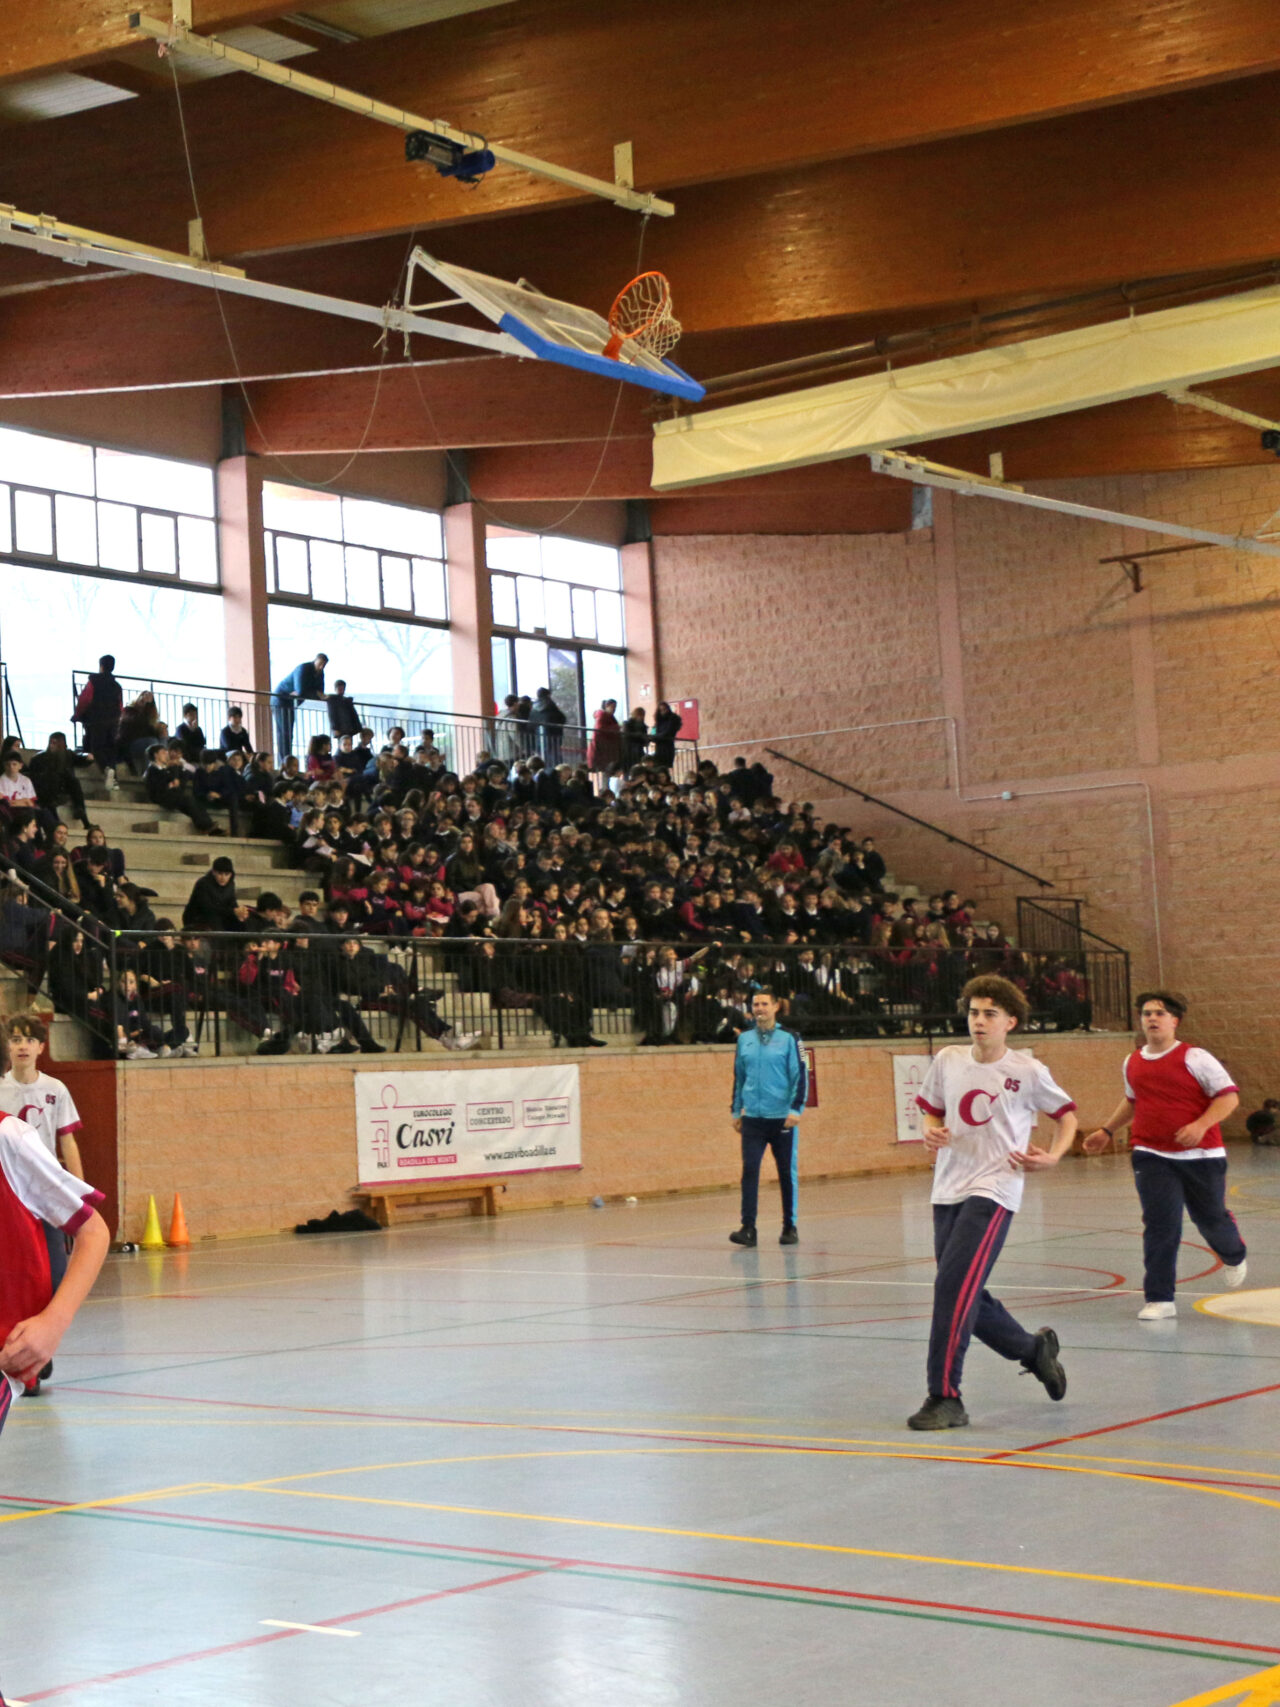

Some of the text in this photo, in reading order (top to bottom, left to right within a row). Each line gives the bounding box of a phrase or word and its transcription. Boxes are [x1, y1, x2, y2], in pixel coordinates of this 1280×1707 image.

[1004, 1077, 1021, 1093] 05
[476, 1107, 504, 1116] CENTRO
[958, 1088, 1000, 1126] C
[396, 1121, 455, 1149] Casvi
